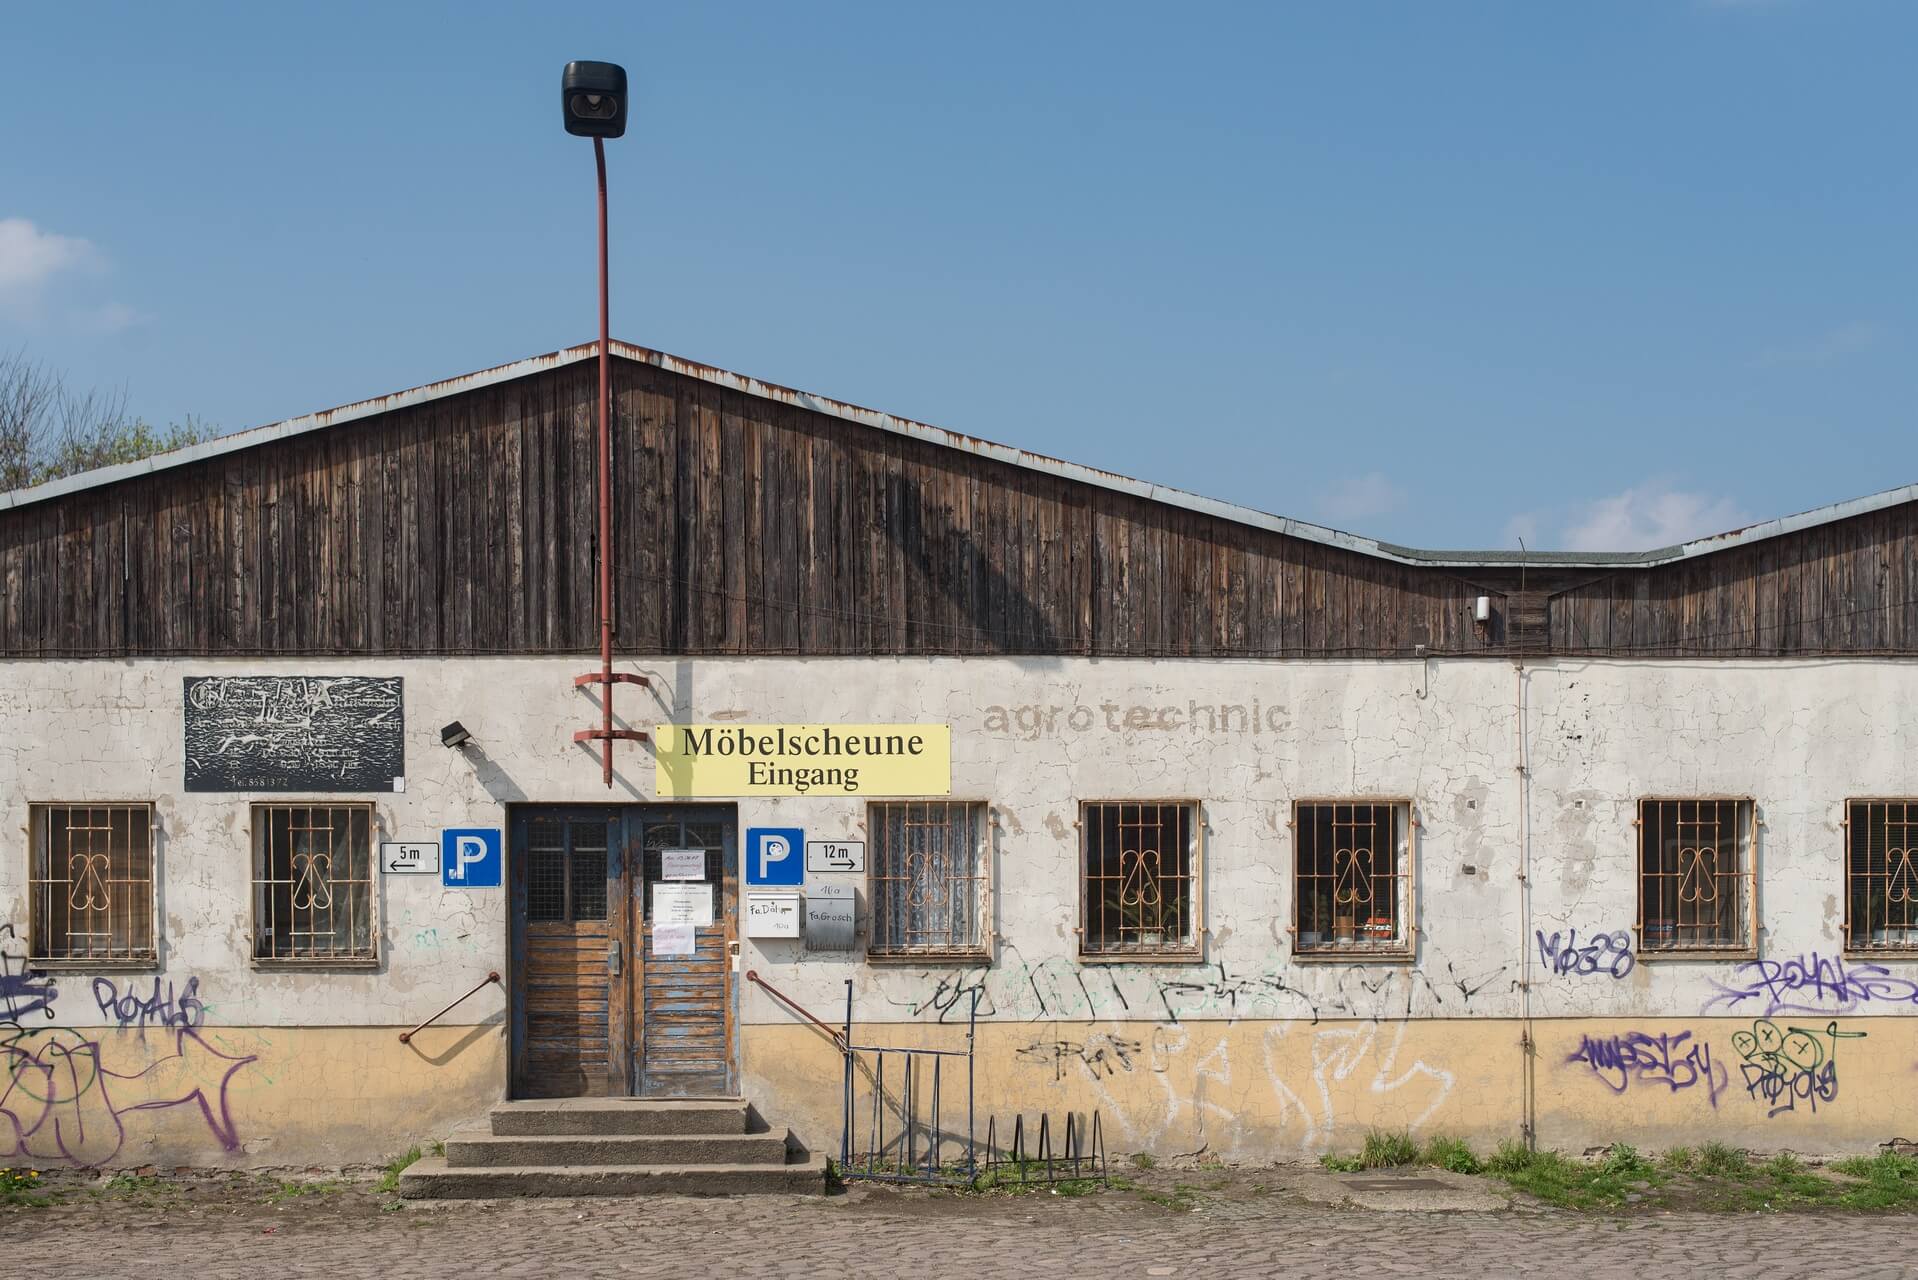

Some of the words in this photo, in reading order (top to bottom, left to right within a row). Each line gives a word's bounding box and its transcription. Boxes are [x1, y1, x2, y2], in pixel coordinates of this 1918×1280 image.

[983, 698, 1292, 742] agrotechnic
[682, 727, 924, 756] Möbelscheune
[748, 761, 859, 792] Eingang
[399, 846, 407, 860] 5
[409, 849, 420, 860] m
[456, 836, 488, 879] P
[759, 835, 791, 878] P
[823, 845, 836, 859] 12
[838, 848, 849, 859] m
